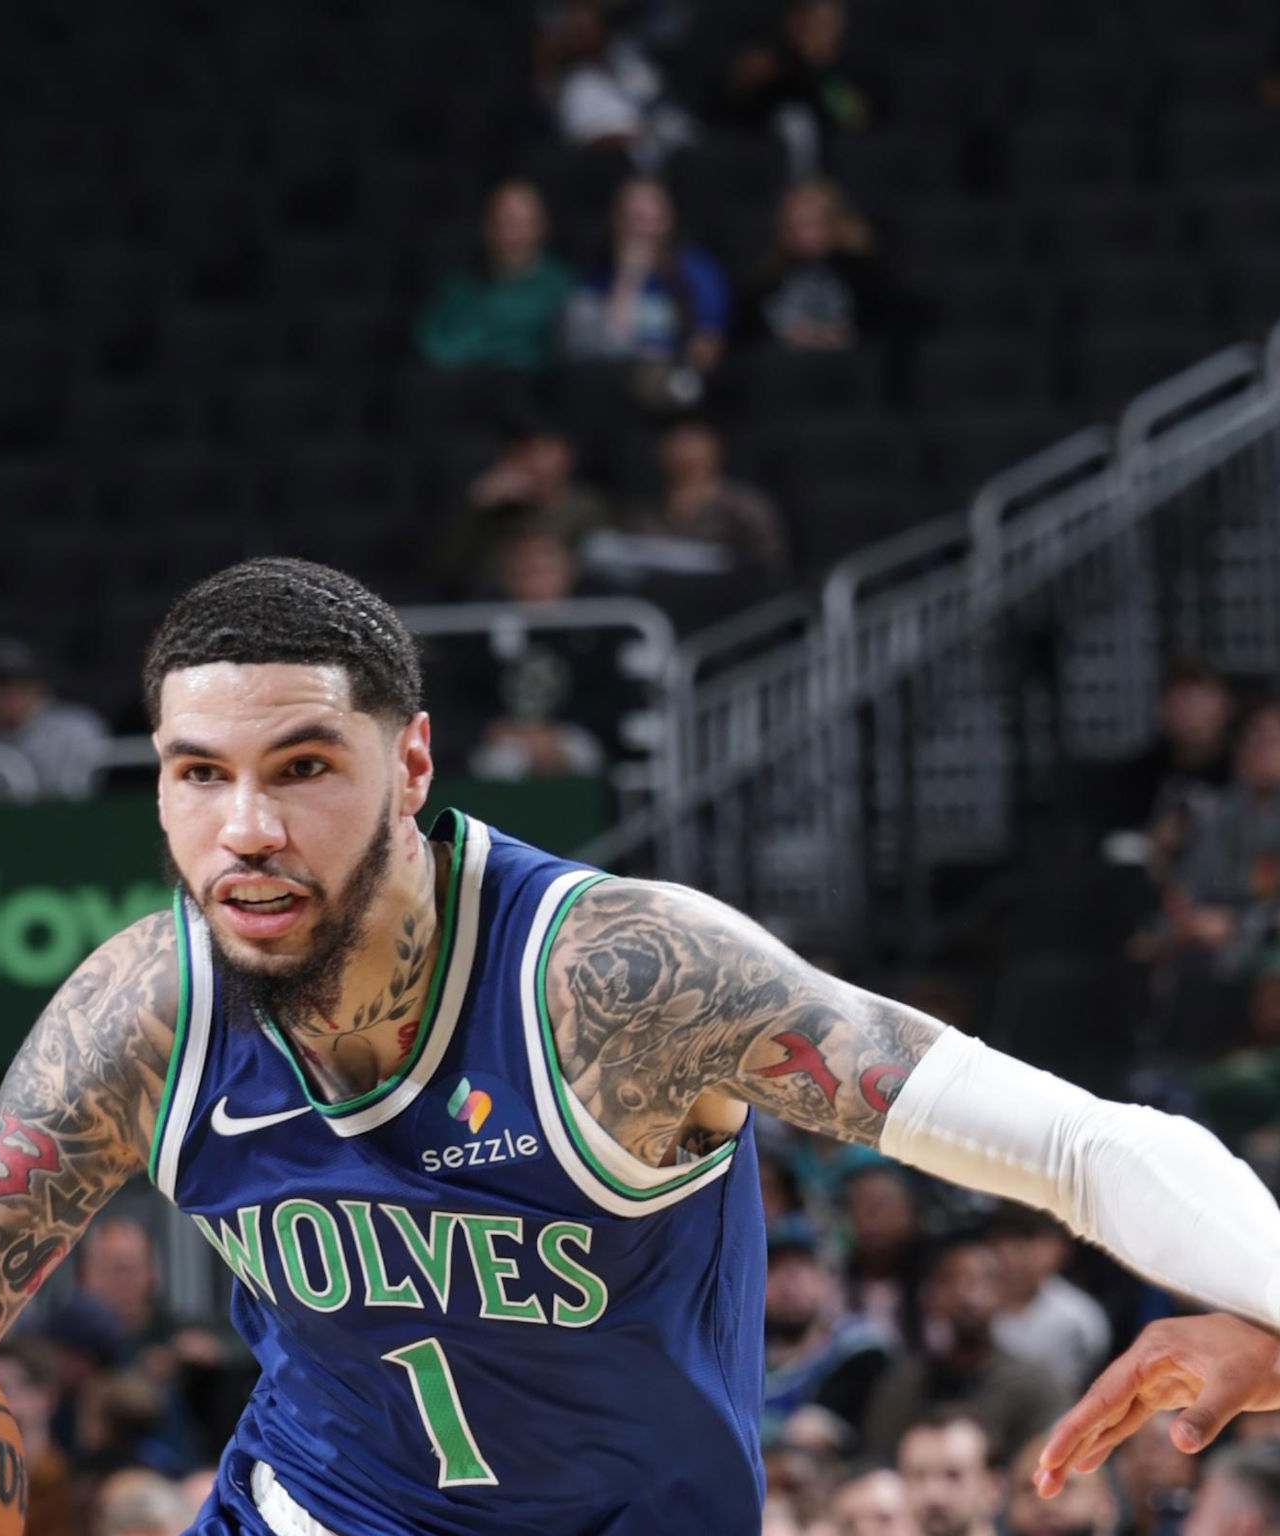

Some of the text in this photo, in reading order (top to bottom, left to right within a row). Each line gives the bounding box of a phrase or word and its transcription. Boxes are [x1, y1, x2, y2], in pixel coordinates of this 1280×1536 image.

[421, 1128, 540, 1173] sezzle
[191, 1198, 609, 1329] WOLVES
[381, 1336, 500, 1489] 1
